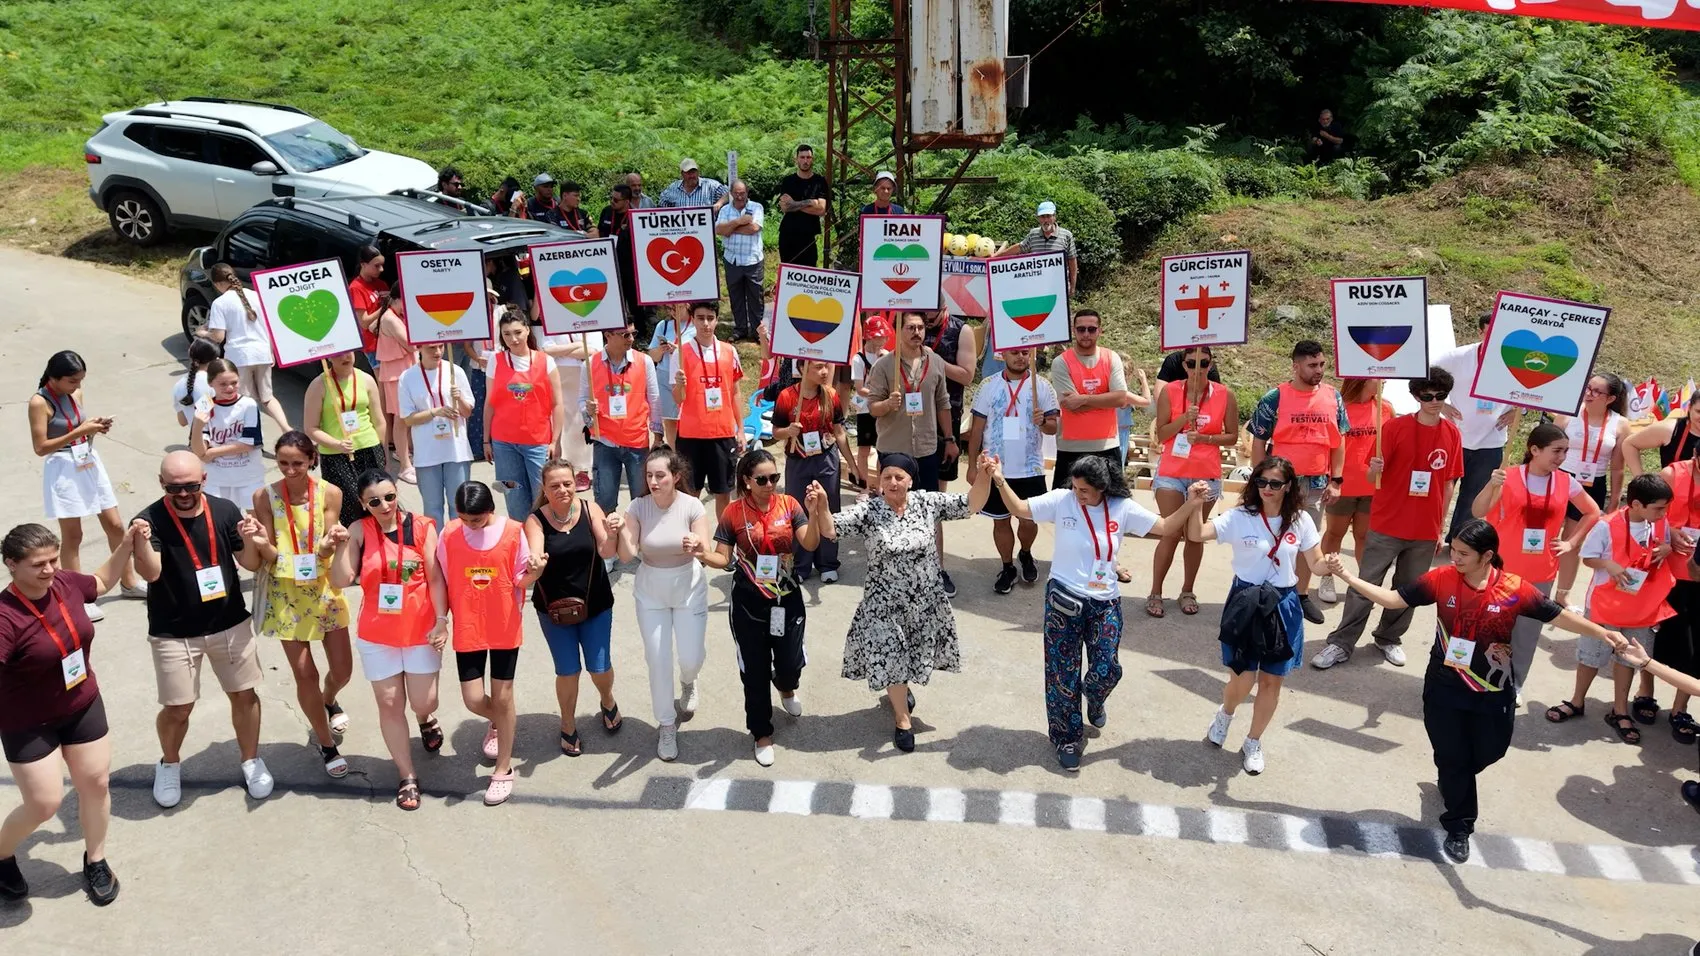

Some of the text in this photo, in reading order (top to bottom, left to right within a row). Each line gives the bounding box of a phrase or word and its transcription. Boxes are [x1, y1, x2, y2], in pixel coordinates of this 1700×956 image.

[638, 210, 707, 229] TÜRKİYE
[883, 219, 922, 236] İRAN
[538, 247, 608, 262] AZERBAYCAN
[421, 258, 462, 268] OSETYA
[990, 257, 1063, 274] BULGARİSTAN
[1169, 257, 1242, 273] GÜRCİSTAN
[268, 267, 333, 289] ADYGEA
[787, 271, 851, 288] KOLOMBİYA
[288, 282, 316, 293] DJIGIT
[1348, 284, 1407, 299] RUSYA
[1499, 302, 1551, 317] KARAÇAY
[1560, 312, 1602, 326] ÇERKES
[1530, 317, 1565, 328] ORAYDA
